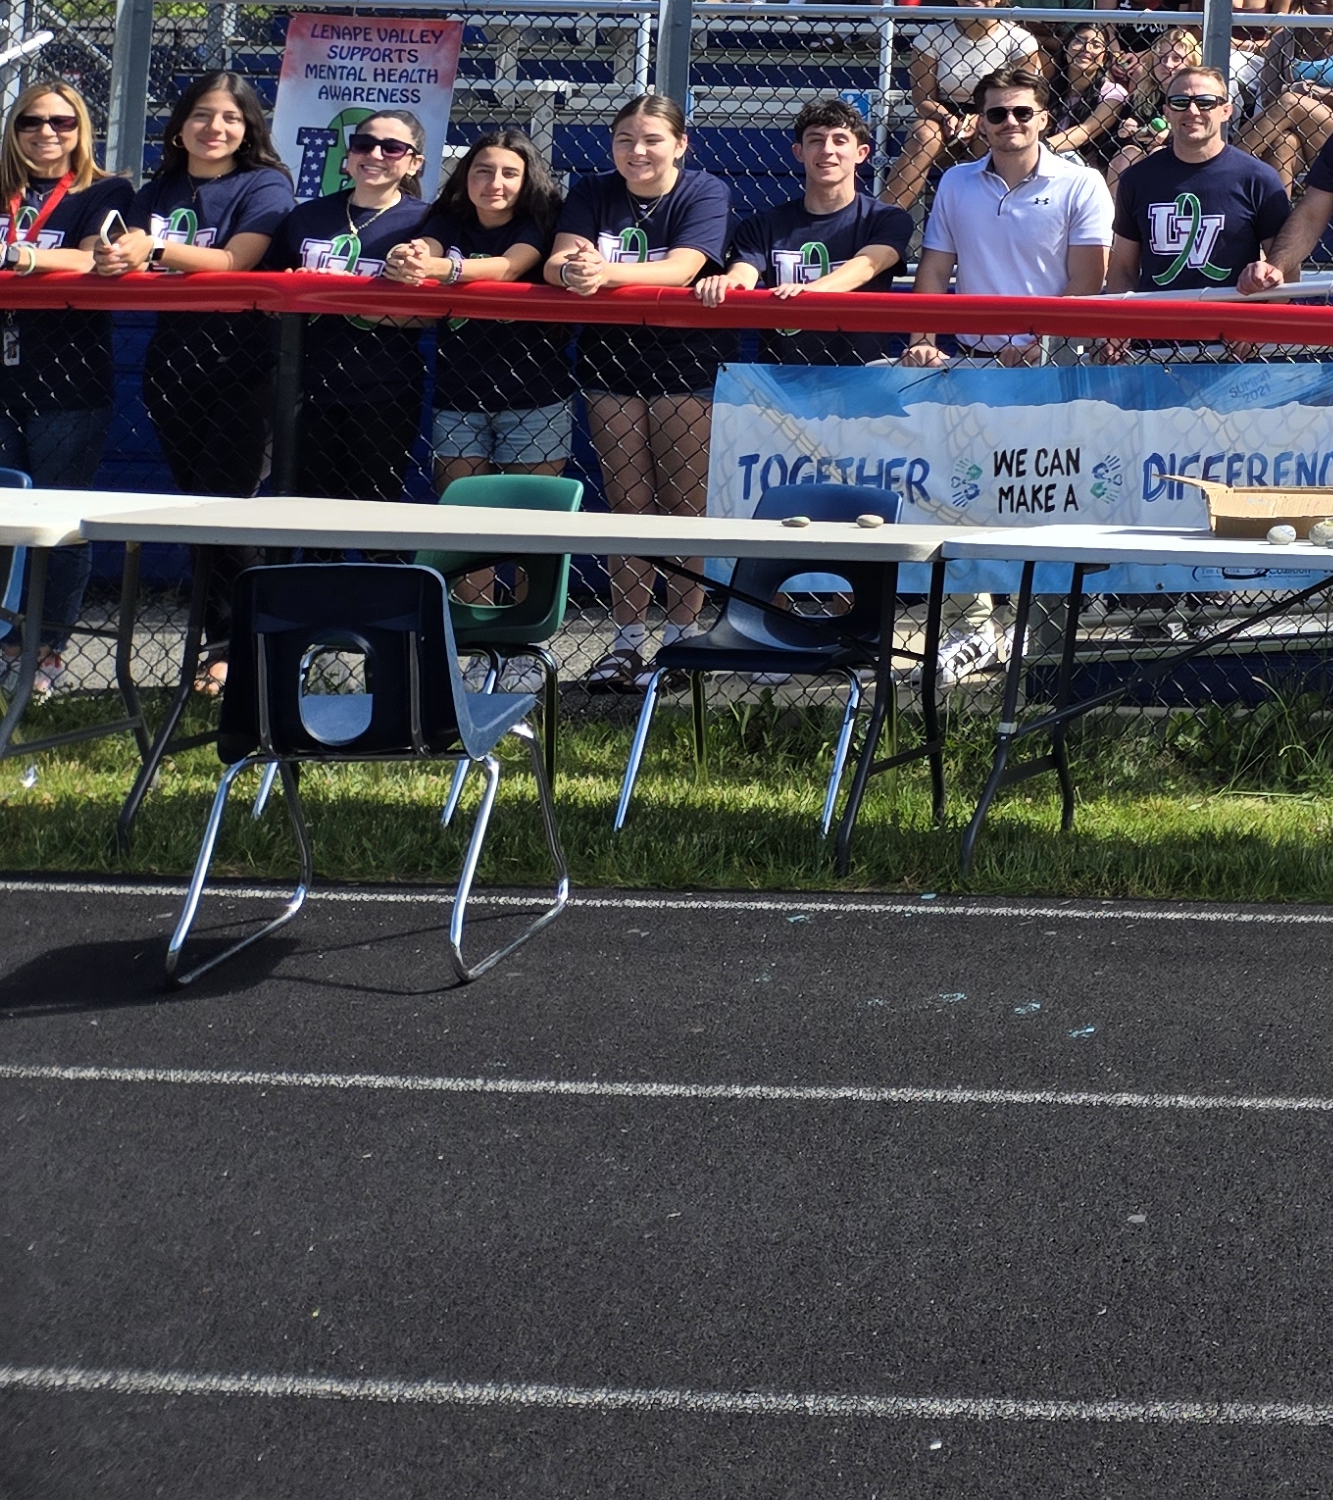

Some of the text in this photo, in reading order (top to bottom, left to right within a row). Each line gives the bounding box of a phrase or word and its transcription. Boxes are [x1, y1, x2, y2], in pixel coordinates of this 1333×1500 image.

[310, 23, 444, 44] LENAPE VALLEY
[327, 45, 419, 63] SUPPORTS
[304, 63, 438, 84] MENTAL HEALTH
[317, 84, 421, 104] AWARENESS
[1147, 201, 1225, 269] LV
[1242, 383, 1271, 404] 2021
[993, 447, 1080, 479] WE CAN
[738, 453, 931, 504] TOGETHER
[998, 484, 1079, 514] MAKE A
